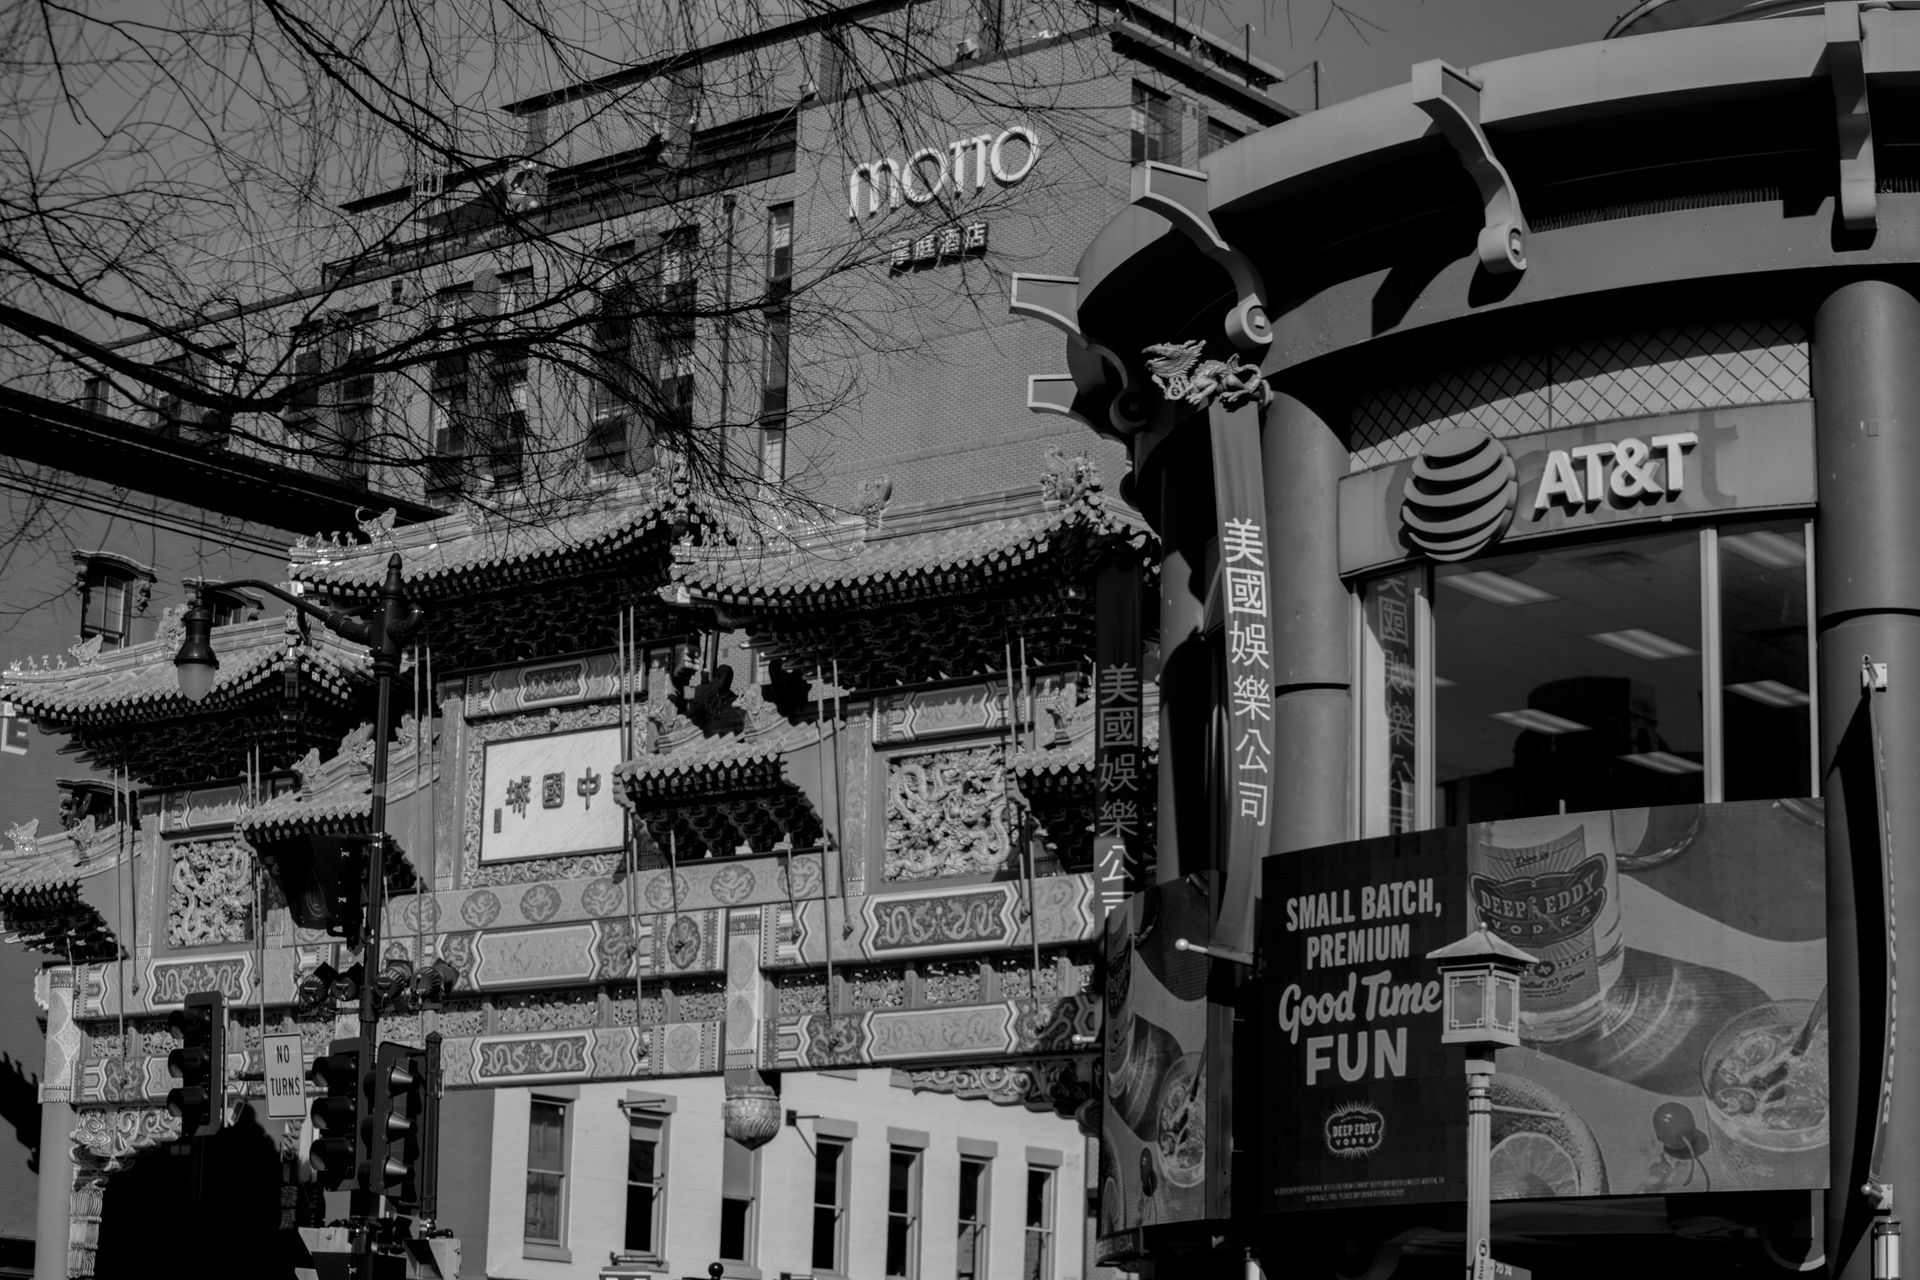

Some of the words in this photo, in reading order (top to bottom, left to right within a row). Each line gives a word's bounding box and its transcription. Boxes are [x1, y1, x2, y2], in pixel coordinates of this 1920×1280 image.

[1533, 431, 1698, 511] AT&T
[1223, 517, 1271, 826] 美國娛樂公司
[1286, 888, 1356, 932] SMALL
[1360, 877, 1442, 920] BATCH,
[1480, 889, 1527, 919] DEEP
[1543, 870, 1596, 914] EDDY
[1491, 905, 1590, 935] VODKA
[1306, 923, 1410, 970] PREMIUM
[1278, 971, 1357, 1045] Good
[1360, 969, 1443, 1022] Time
[276, 1045, 290, 1064] NO
[1306, 1026, 1408, 1086] FUN
[270, 1077, 301, 1097] TURNS
[1332, 1124, 1353, 1138] DEEP
[1335, 1135, 1374, 1147] VODKA
